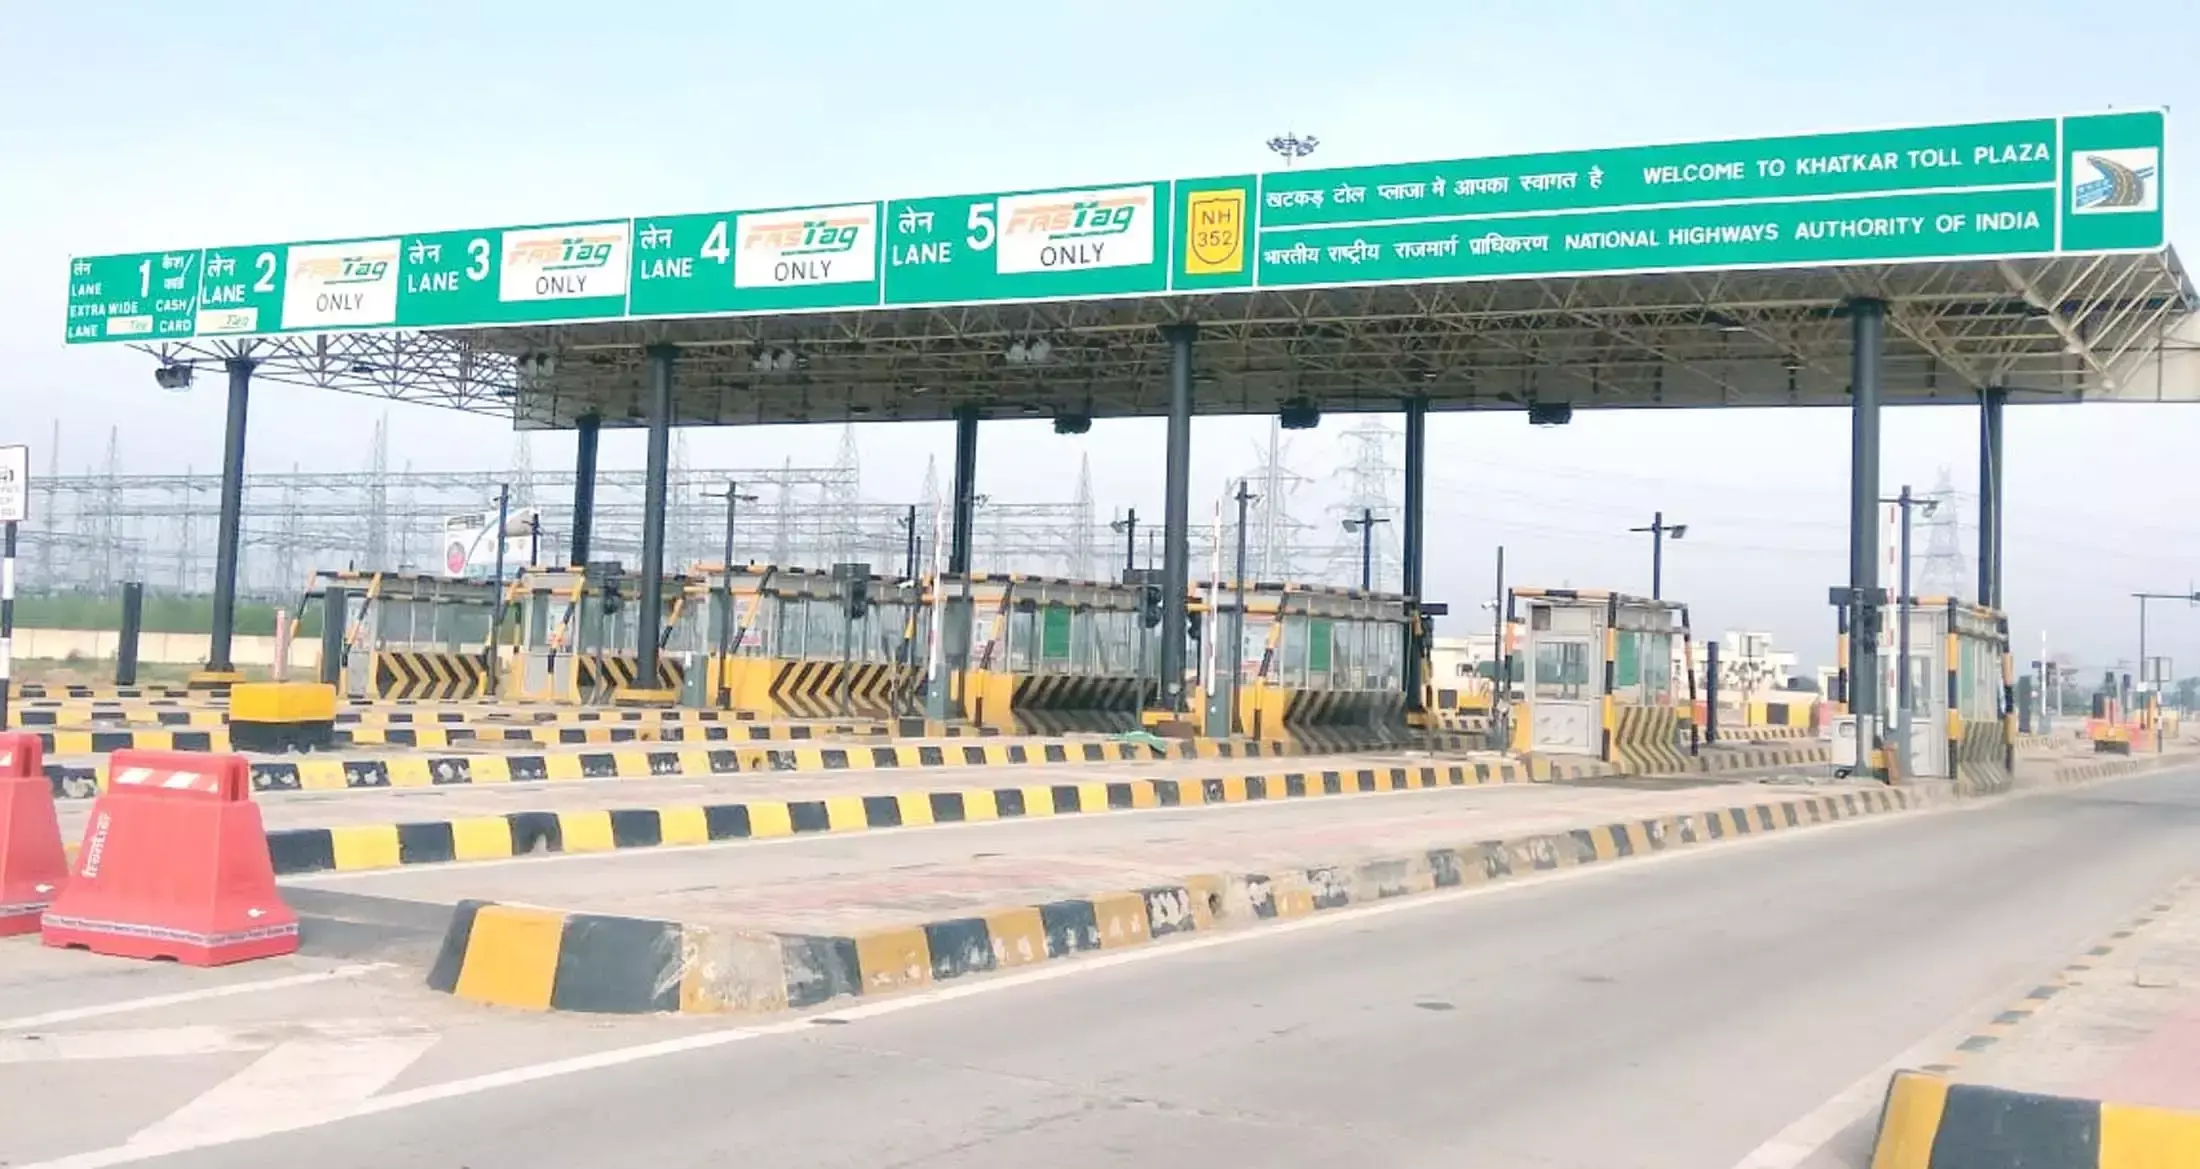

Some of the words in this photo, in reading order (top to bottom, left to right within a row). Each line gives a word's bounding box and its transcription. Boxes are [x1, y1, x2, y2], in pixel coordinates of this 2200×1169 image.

[1643, 161, 1745, 185] WELCOME
[1756, 158, 1786, 178] TO
[1795, 151, 1899, 176] KHATKAR
[1907, 148, 1963, 168] TOLL
[1973, 142, 2050, 166] PLAZA
[1332, 181, 1367, 204] टोल
[1376, 182, 1425, 201] प्लाजा
[1453, 176, 1509, 197] आपका
[1519, 172, 1577, 192] स्वागत
[1587, 164, 1605, 189] है
[897, 205, 935, 236] लेन
[966, 202, 996, 252] 5
[1201, 210, 1232, 226] NH
[1564, 228, 1660, 251] NATIONAL
[1667, 222, 1780, 246] HIGHWAYS
[1794, 215, 1925, 241] AUTHORITY
[1935, 213, 1968, 234] OF
[1975, 210, 2042, 232] INDIA
[639, 223, 673, 250] लेन
[700, 221, 731, 265] 4
[1197, 231, 1234, 248] 352
[407, 239, 443, 265] लेन
[465, 238, 491, 282] 3
[891, 243, 953, 267] LANE
[1040, 241, 1106, 266] ONLY
[1263, 241, 1321, 265] भारतीय
[1327, 238, 1382, 265] राष्ट्रीय
[1393, 234, 1460, 259] राजमार्ग
[139, 258, 152, 298] 1
[207, 253, 237, 279] लेन
[253, 252, 277, 293] 2
[640, 256, 693, 280] LANE
[774, 260, 832, 281] ONLY
[71, 282, 103, 297] LANE
[201, 284, 246, 305] LANE
[407, 271, 460, 293] LANE
[535, 275, 588, 296] ONLY
[70, 303, 106, 318] EXTRA
[108, 300, 139, 316] WIDE
[316, 293, 364, 312] ONLY
[68, 323, 99, 339] LANE
[159, 319, 192, 333] CARD
